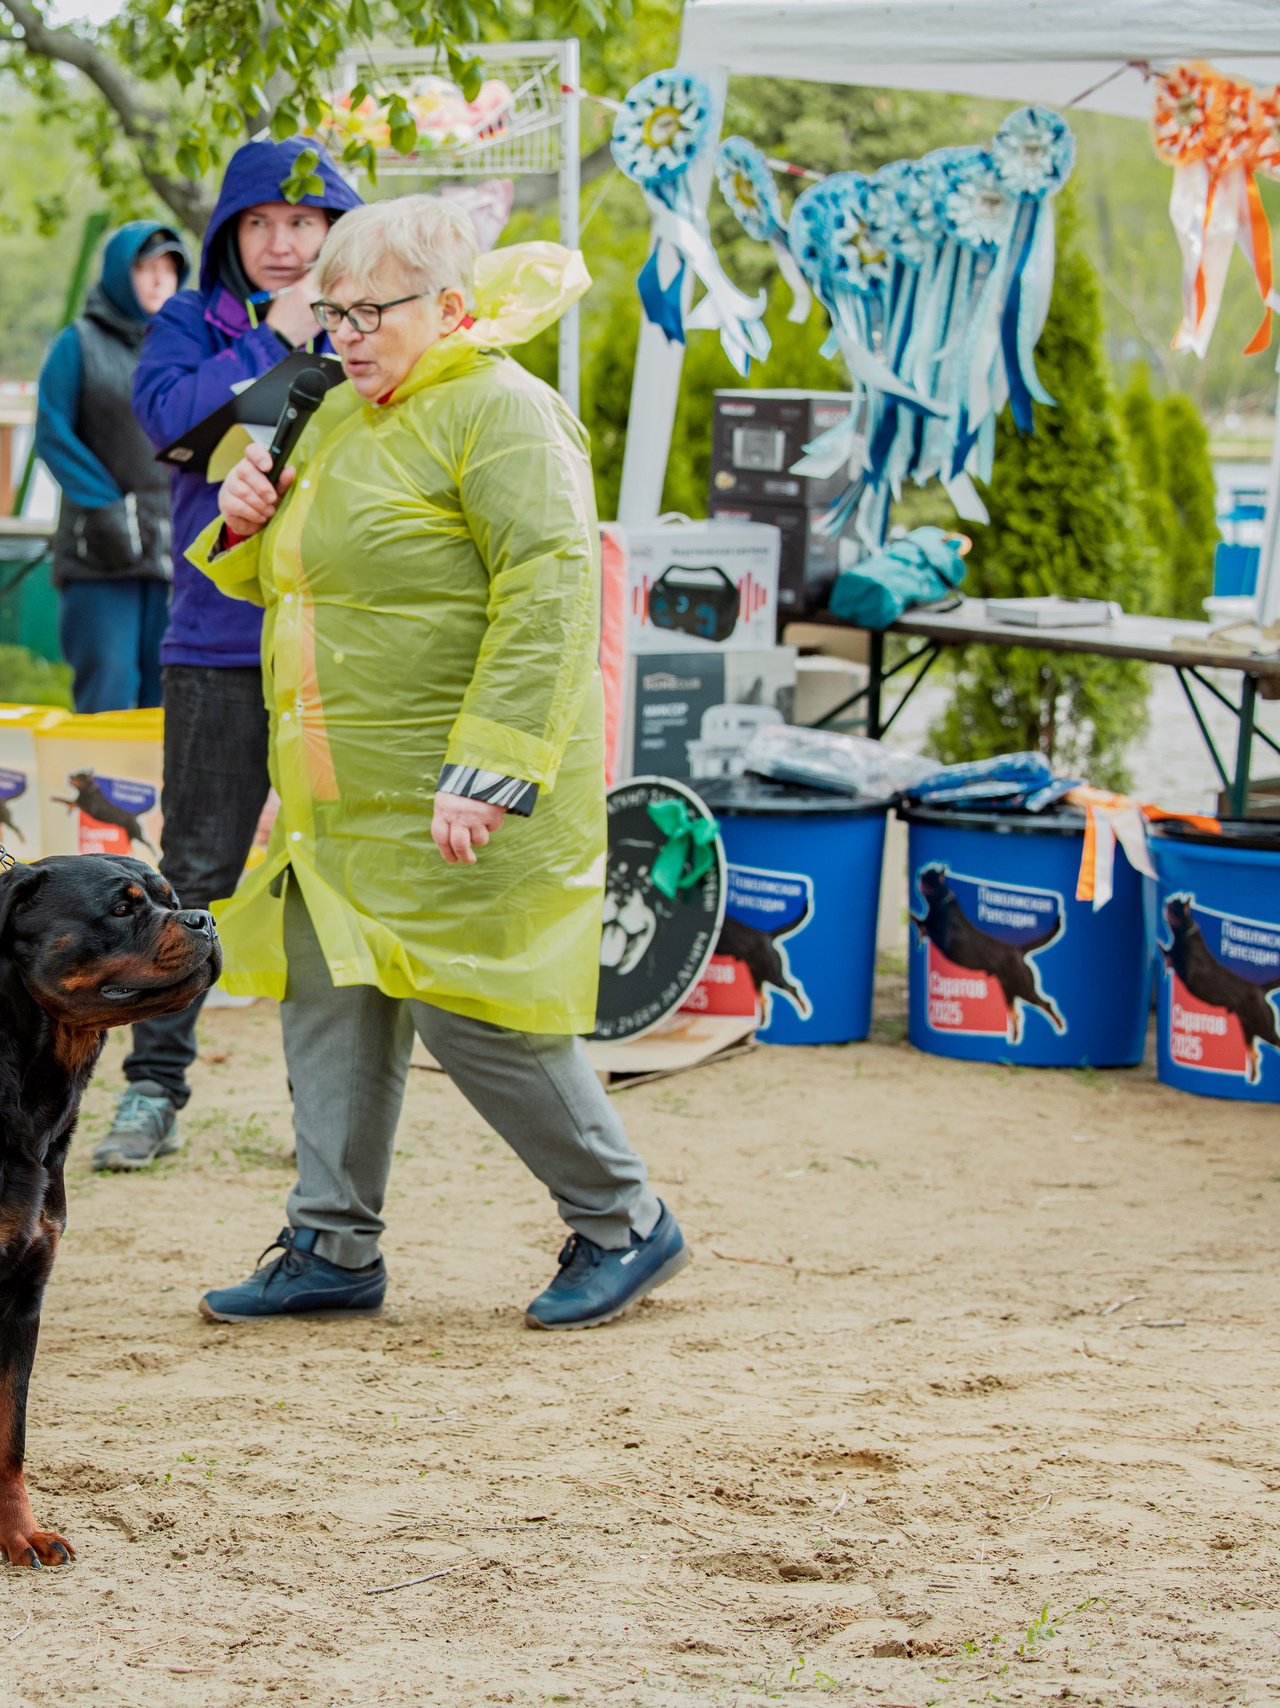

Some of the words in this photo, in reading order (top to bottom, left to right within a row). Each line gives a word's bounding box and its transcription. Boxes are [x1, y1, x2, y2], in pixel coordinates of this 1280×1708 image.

[978, 886, 1053, 913] Поволжская
[978, 904, 1038, 929] Рапсодия
[1221, 938, 1279, 966] Рапсодия
[929, 971, 987, 999] Саратов
[929, 1000, 963, 1025] 2025
[1173, 1004, 1227, 1035] Саратов
[1172, 1032, 1203, 1060] 2025
